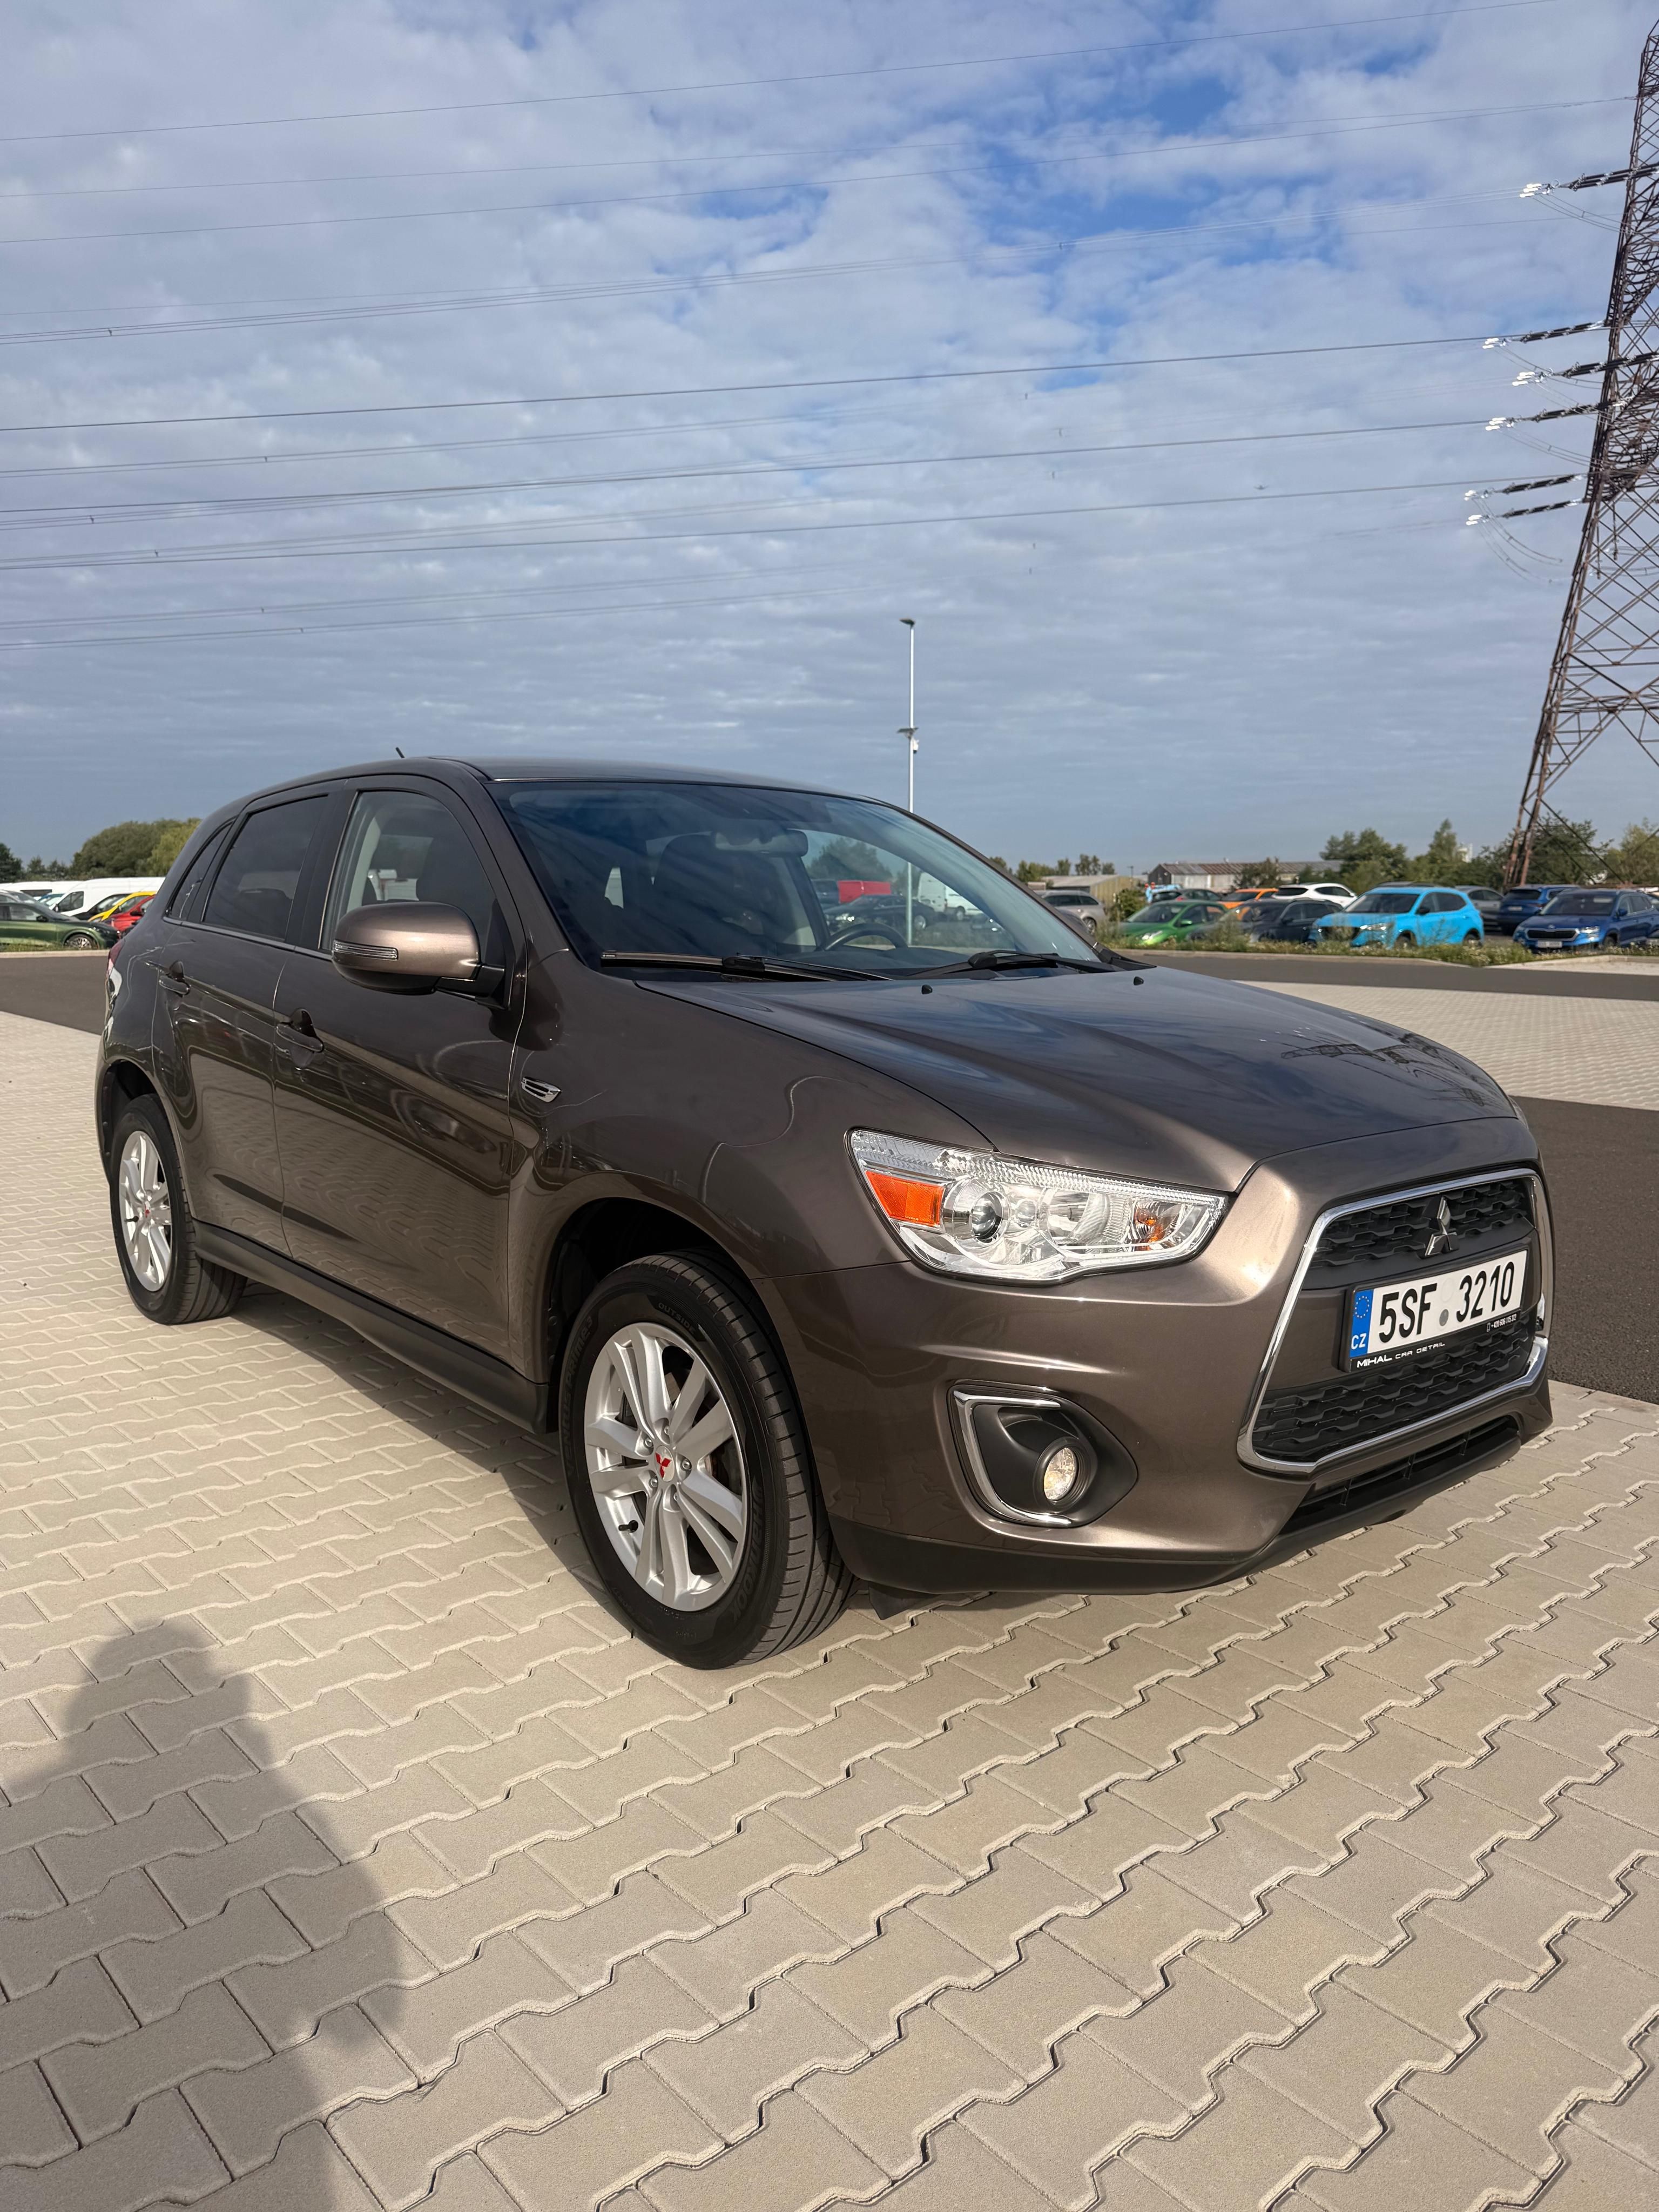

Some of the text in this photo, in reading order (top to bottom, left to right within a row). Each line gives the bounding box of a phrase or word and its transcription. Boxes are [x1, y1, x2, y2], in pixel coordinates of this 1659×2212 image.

[1378, 1261, 1515, 1343] 5SF 3210
[658, 1301, 696, 1334] OUTSIDE
[1351, 1333, 1367, 1350] CZ
[1357, 1342, 1445, 1368] MIHAL CAR DETAIL
